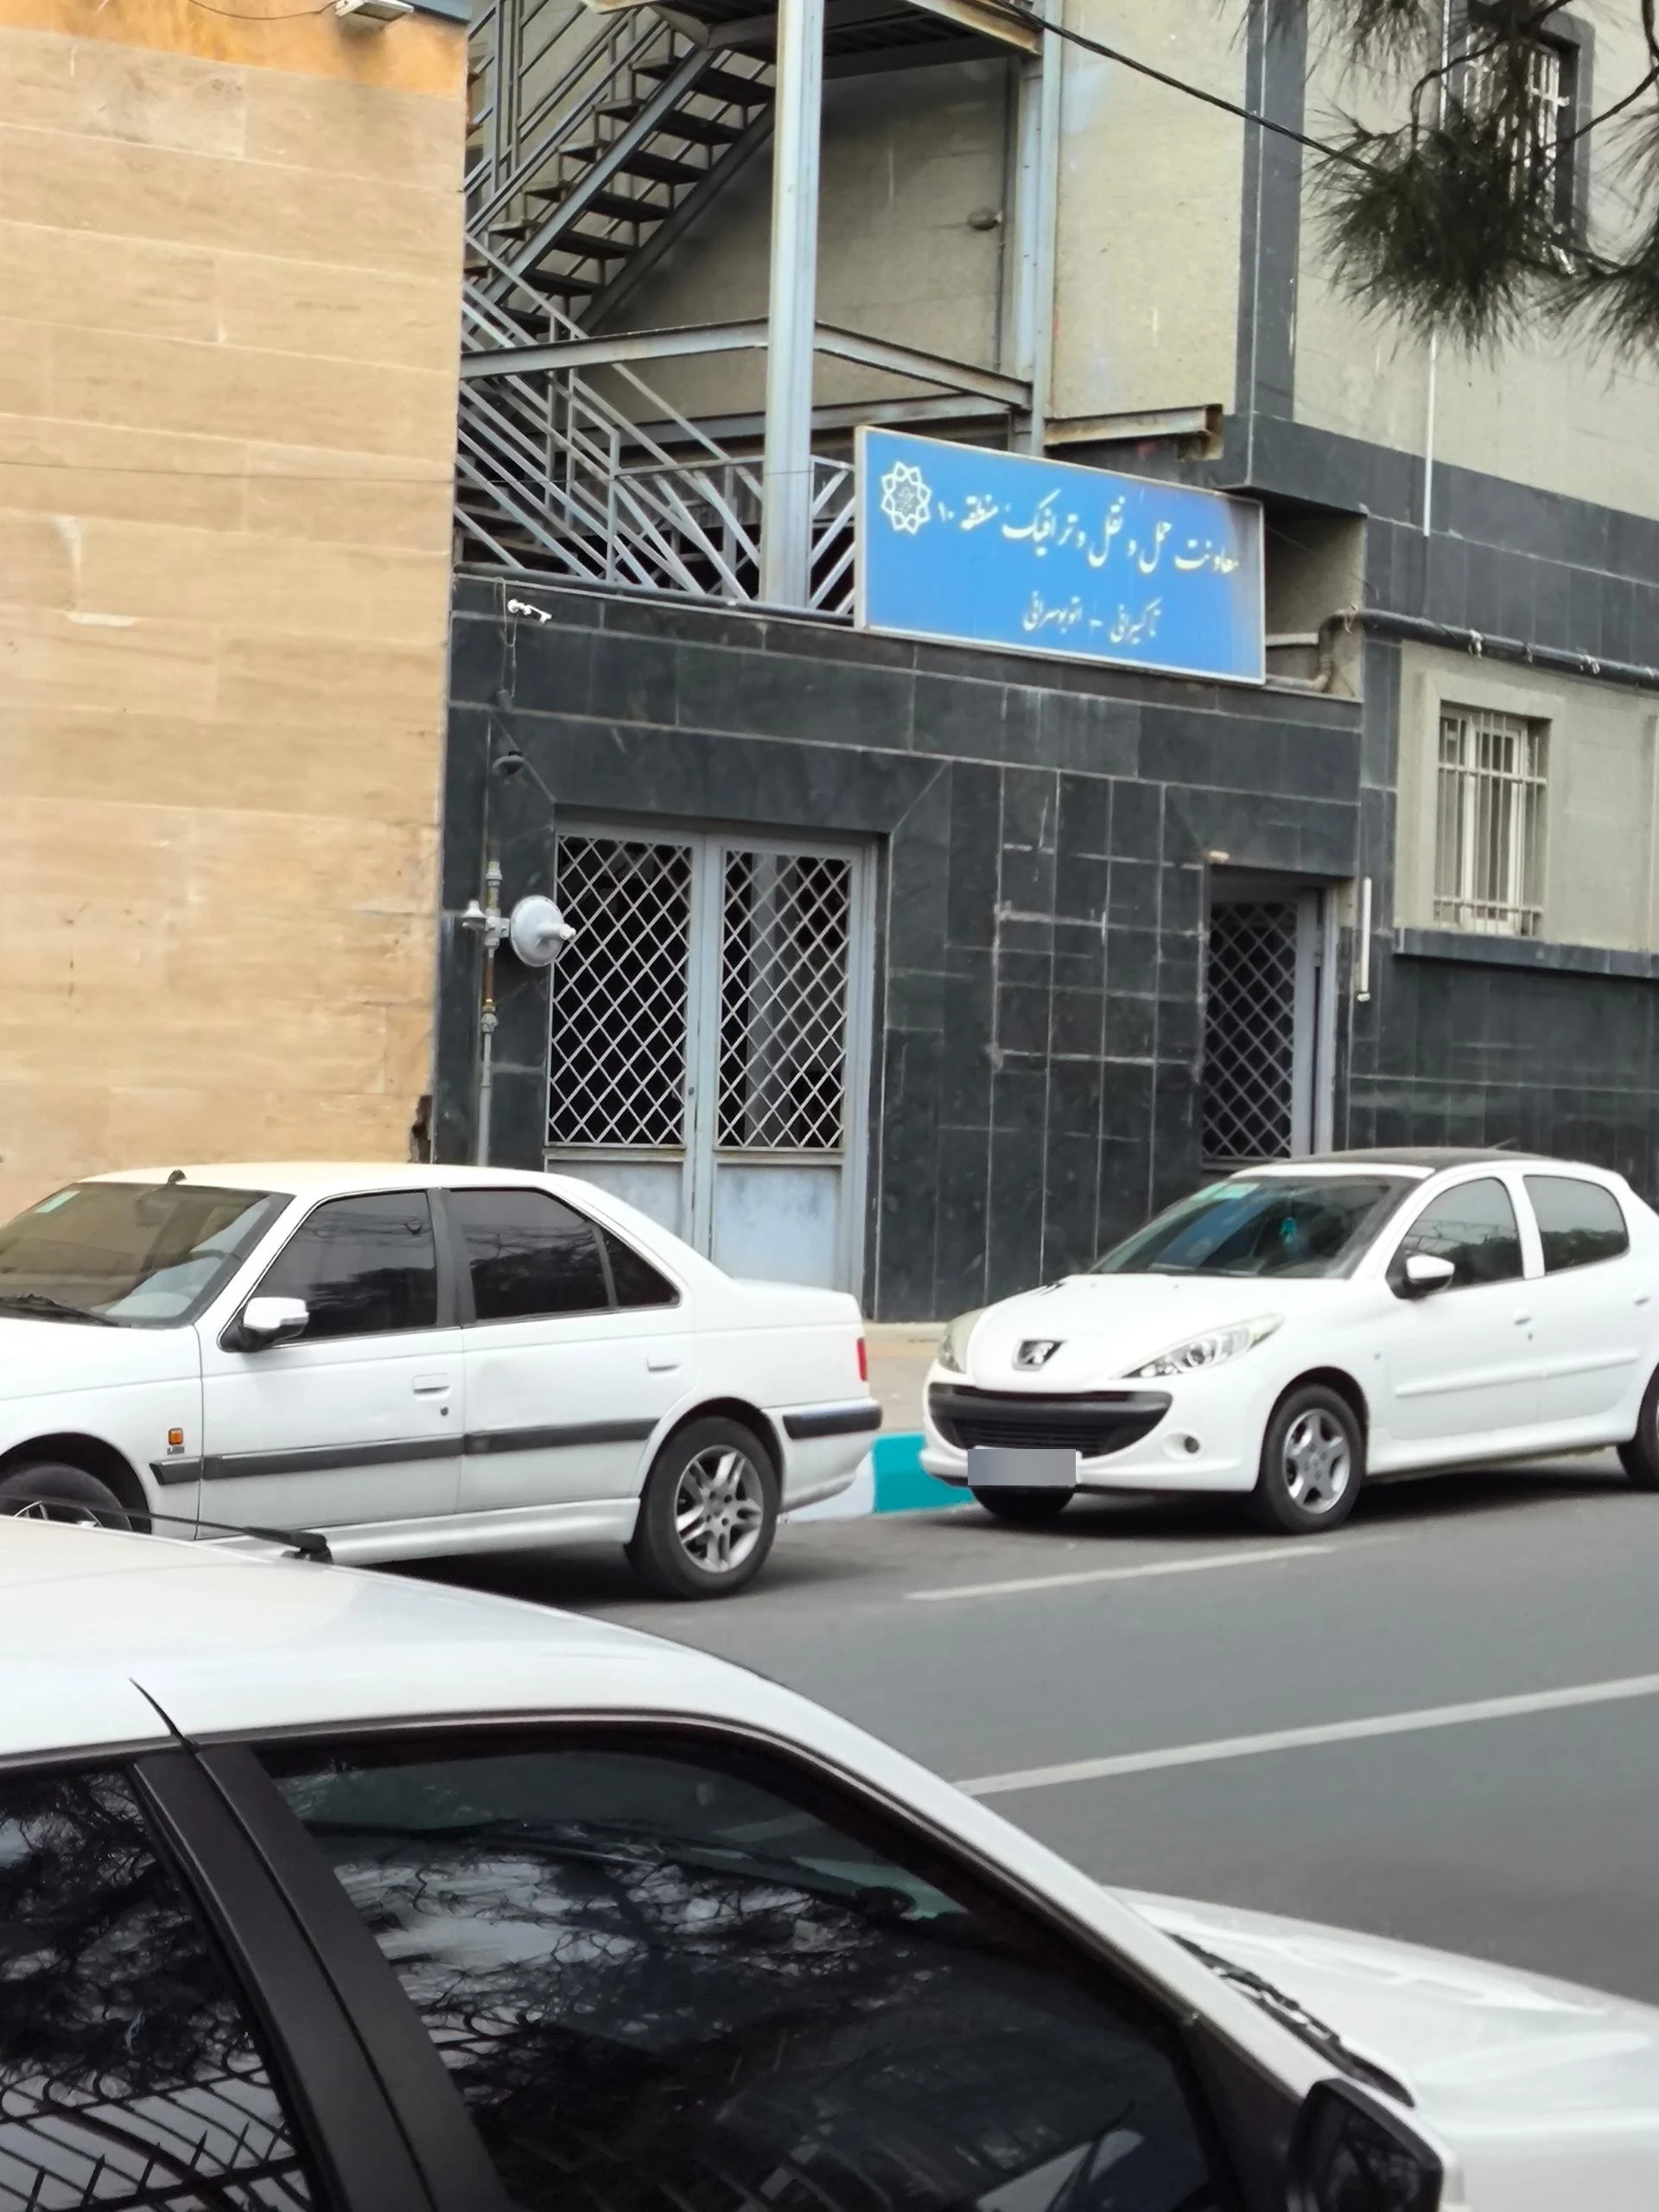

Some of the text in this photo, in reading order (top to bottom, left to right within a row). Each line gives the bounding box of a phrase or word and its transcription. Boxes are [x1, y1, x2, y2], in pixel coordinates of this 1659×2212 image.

[960, 493, 999, 531] منطقه
[1001, 487, 1079, 557] ترافیک
[1088, 495, 1126, 568] نقل
[1076, 530, 1086, 549] و
[1127, 538, 1138, 557] و
[1138, 521, 1173, 574] حمل
[1174, 538, 1240, 574] معاونت
[1023, 590, 1083, 634] اتوبوسرانی
[1109, 597, 1163, 644] تاکسیرانی
